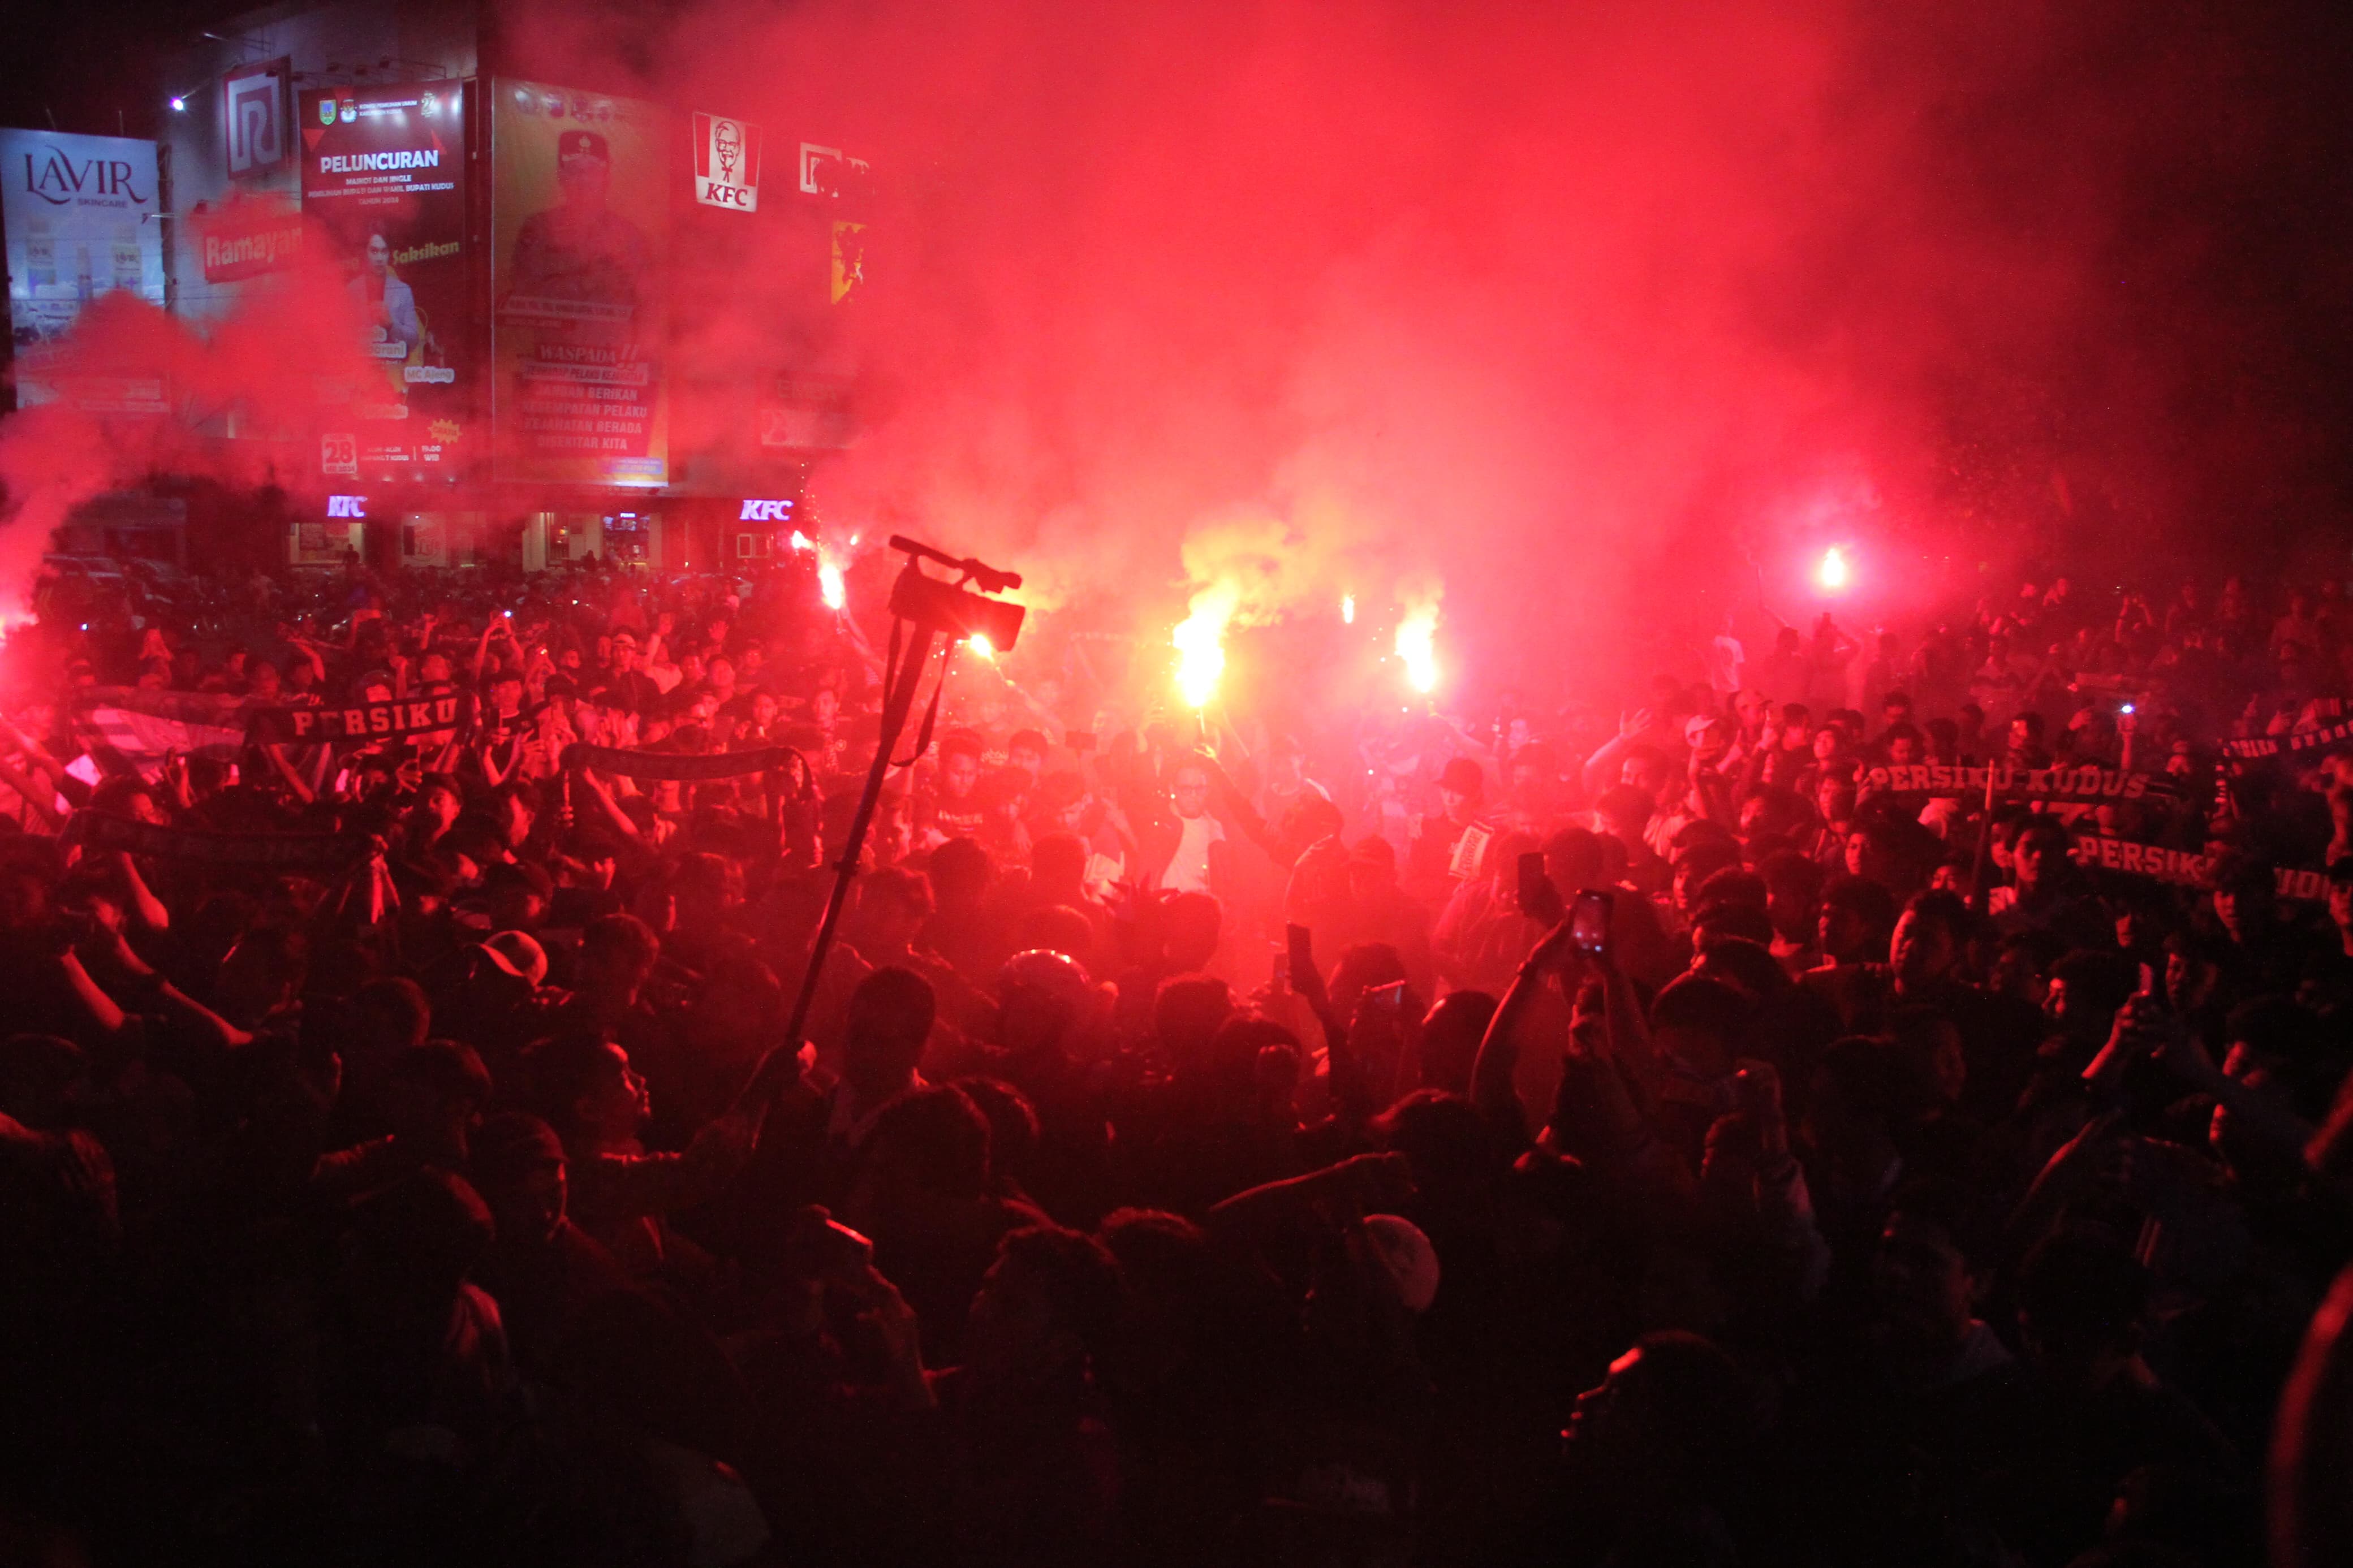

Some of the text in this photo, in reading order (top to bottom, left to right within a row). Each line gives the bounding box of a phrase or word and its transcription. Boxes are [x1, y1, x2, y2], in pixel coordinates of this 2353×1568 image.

[321, 150, 438, 173] PELUNCURAN
[25, 145, 148, 205] LAVIR
[77, 198, 128, 208] SKINCARE
[705, 182, 748, 206] KFC
[393, 241, 459, 265] Saksikan
[588, 387, 637, 401] BERIKAN
[603, 404, 648, 419] PELAKU
[596, 420, 643, 434] BERADA
[325, 440, 354, 464] 28
[602, 437, 628, 451] KITA
[739, 500, 793, 520] KFC
[1869, 765, 2150, 798] PERSIKU KUDUS
[2075, 836, 2217, 879] PERSIK
